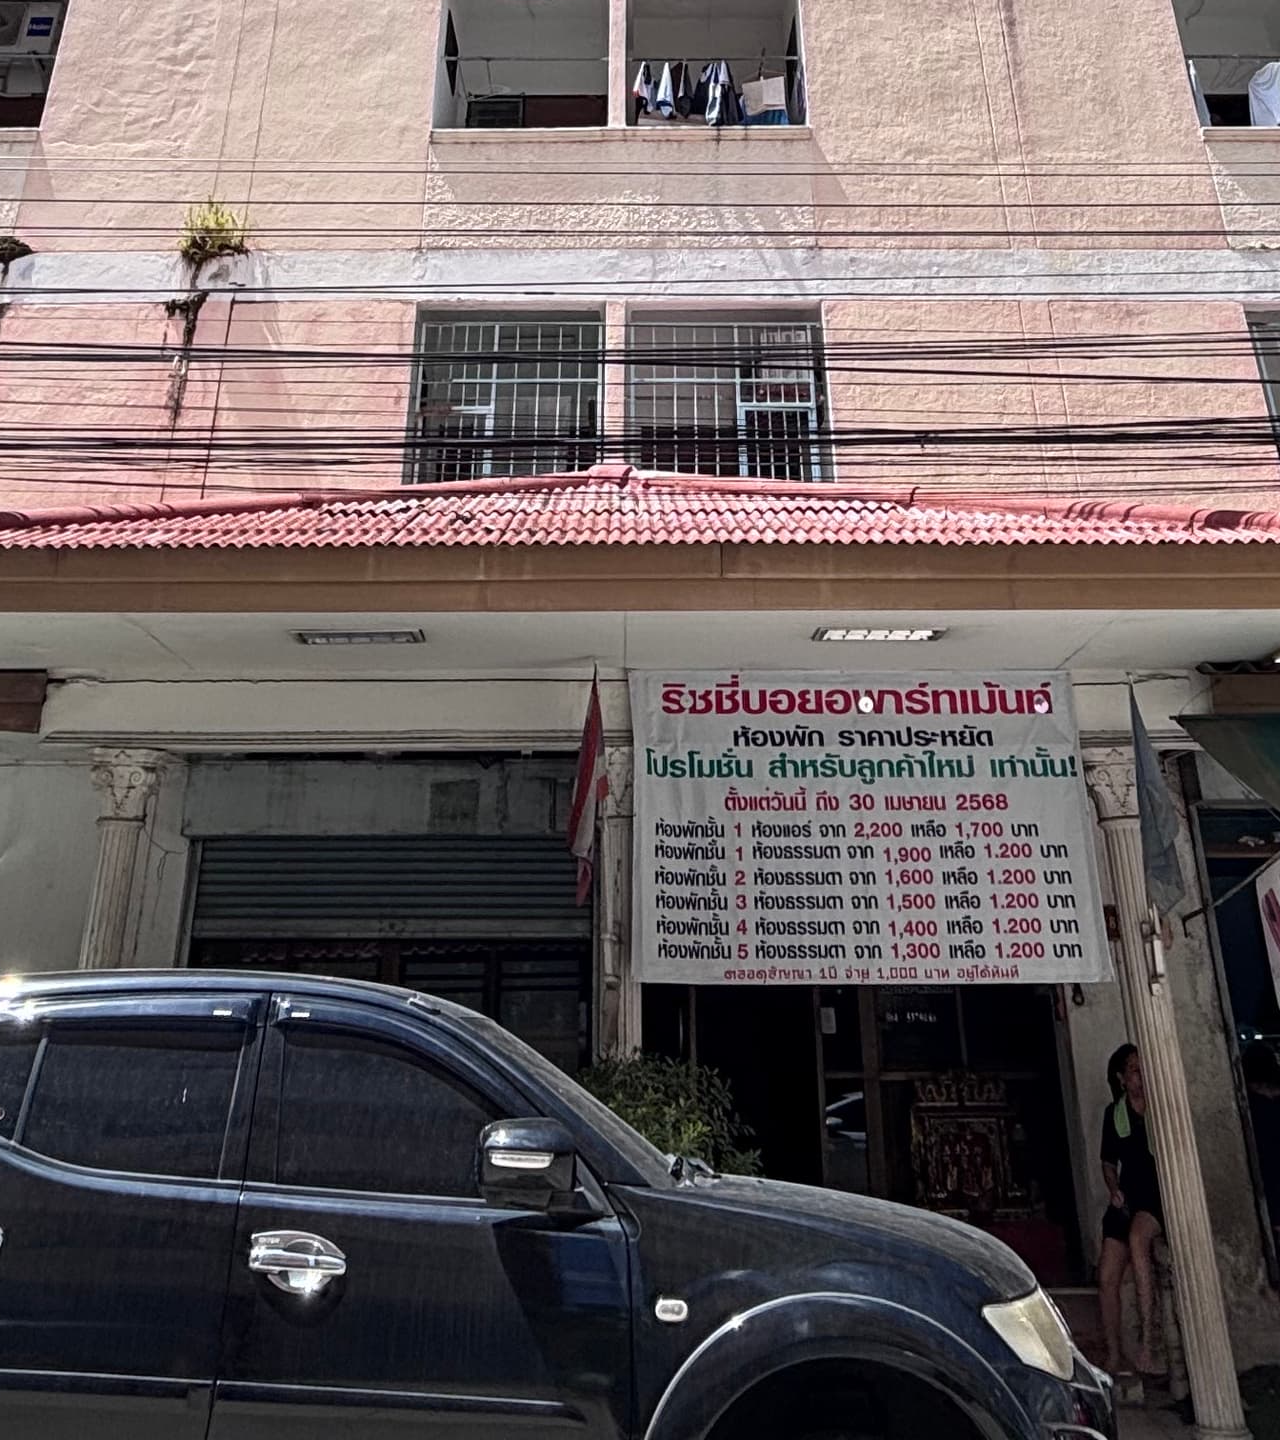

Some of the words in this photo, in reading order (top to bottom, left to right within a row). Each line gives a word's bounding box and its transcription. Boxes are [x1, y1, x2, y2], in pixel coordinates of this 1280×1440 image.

[733, 726, 824, 748] ห้องพัก
[838, 725, 993, 747] ราคาประหยัด
[646, 748, 753, 778] โปรโมชั่น
[769, 750, 975, 784] สำหรับลูกค้าใหม่
[990, 747, 1077, 777] เท่านั้น!
[725, 786, 806, 811] ตั้งแต่วันนี้
[816, 790, 839, 811] ถึง
[849, 794, 874, 811] 30
[885, 796, 946, 811] เมษายน
[956, 793, 1008, 811] 2568
[656, 816, 724, 838] ห้องพักชั้น
[734, 822, 741, 837] 1
[752, 819, 811, 839] ห้องแอร์
[819, 824, 846, 838] จาก
[854, 822, 902, 840] 2,200
[911, 818, 946, 838] เหลือ
[955, 822, 1003, 840] 1,700
[1011, 824, 1039, 837] บาท
[655, 838, 725, 860] ห้องพักชั้น
[736, 846, 742, 861] 1
[753, 841, 840, 859] ห้องธรรมดา
[847, 845, 874, 859] จาก
[884, 847, 931, 865] 1,900
[940, 840, 975, 859] เหลือ
[984, 843, 1032, 858] 1.200
[1040, 845, 1068, 858] บาท
[655, 865, 726, 886] ห้องพักชั้น
[735, 870, 746, 886] 2
[754, 867, 842, 885] ห้องธรรมดา
[849, 871, 876, 885] จาก
[885, 869, 933, 887] 1,600
[942, 866, 978, 885] เหลือ
[987, 869, 1035, 884] 1.200
[1043, 871, 1072, 884] บาท
[656, 888, 728, 911] ห้องพักชั้น
[736, 895, 747, 910] 3
[754, 890, 843, 910] ห้องธรรมดา
[851, 896, 878, 910] จาก
[887, 894, 935, 912] 1,500
[945, 890, 981, 909] เหลือ
[990, 893, 1039, 909] 1.200
[1047, 895, 1076, 908] บาท
[657, 913, 729, 936] ห้องพักชั้น
[737, 919, 747, 935] 4
[755, 917, 845, 935] ห้องธรรมดา
[853, 920, 880, 935] จาก
[889, 920, 937, 939] 1,400
[947, 915, 983, 934] เหลือ
[992, 918, 1041, 934] 1.200
[1050, 919, 1079, 934] บาท
[658, 936, 731, 959] ห้องพักชั้น
[738, 944, 748, 959] 5
[755, 940, 846, 959] ห้องธรรมดา
[854, 945, 882, 959] จาก
[891, 943, 940, 962] 1,300
[949, 939, 986, 959] เหลือ
[995, 942, 1045, 959] 1.200
[1053, 944, 1082, 958] บาท
